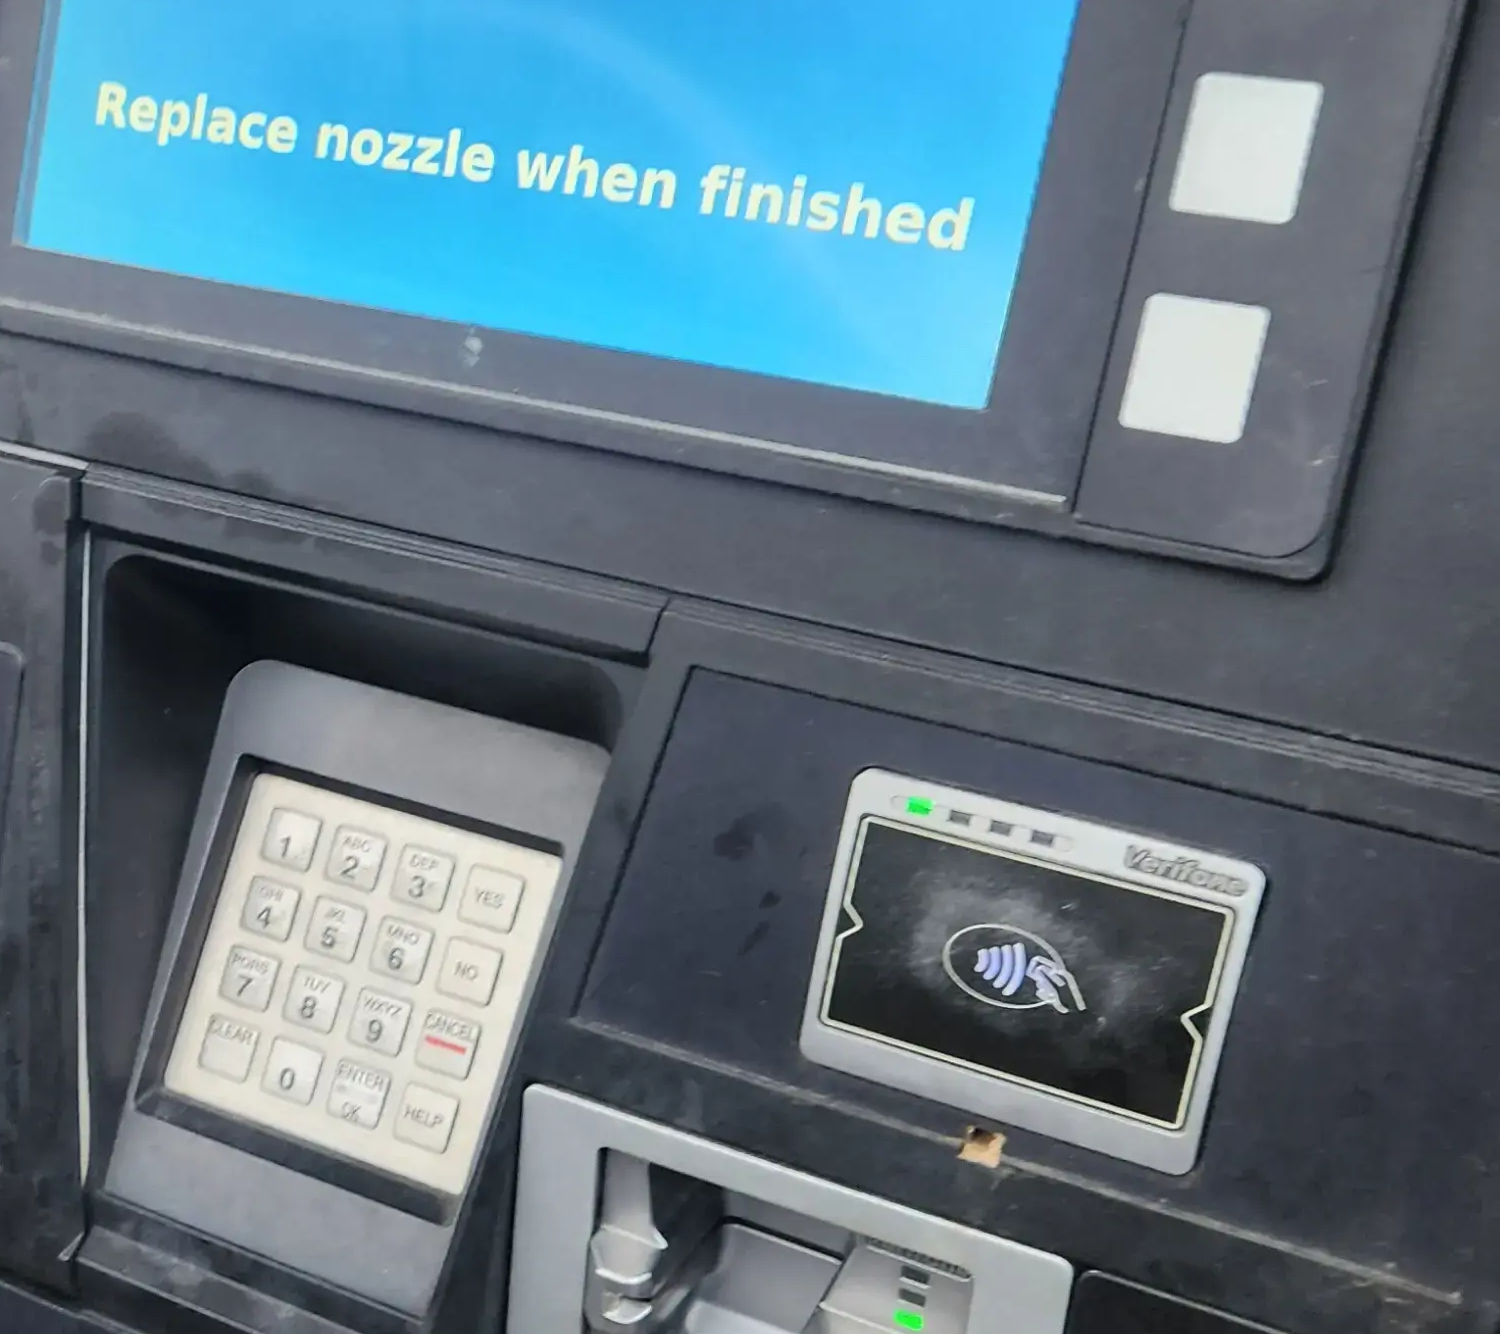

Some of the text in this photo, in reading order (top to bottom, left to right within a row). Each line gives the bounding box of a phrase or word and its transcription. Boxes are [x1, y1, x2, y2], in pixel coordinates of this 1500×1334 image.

[95, 80, 976, 252] Replace nozzle when finished
[280, 836, 291, 859] 1
[341, 835, 371, 853] ABC
[340, 855, 359, 879] 2
[408, 853, 439, 871] DEF
[1123, 844, 1249, 897] Verifone
[408, 874, 426, 899] 3
[474, 886, 506, 909] YES
[256, 906, 273, 929] 4
[320, 926, 339, 949] 5
[388, 924, 420, 945] MNO
[388, 947, 405, 971] 6
[453, 960, 479, 982] NO
[236, 974, 253, 997] 7
[303, 975, 332, 994] TUV
[301, 995, 317, 1019] 8
[208, 1018, 255, 1046] CLEAR
[365, 1019, 383, 1043] 9
[424, 1012, 477, 1041] CANCEL
[279, 1067, 296, 1091] 0
[335, 1062, 385, 1091] ENTER
[341, 1100, 362, 1123] OK
[403, 1103, 445, 1129] HELP
